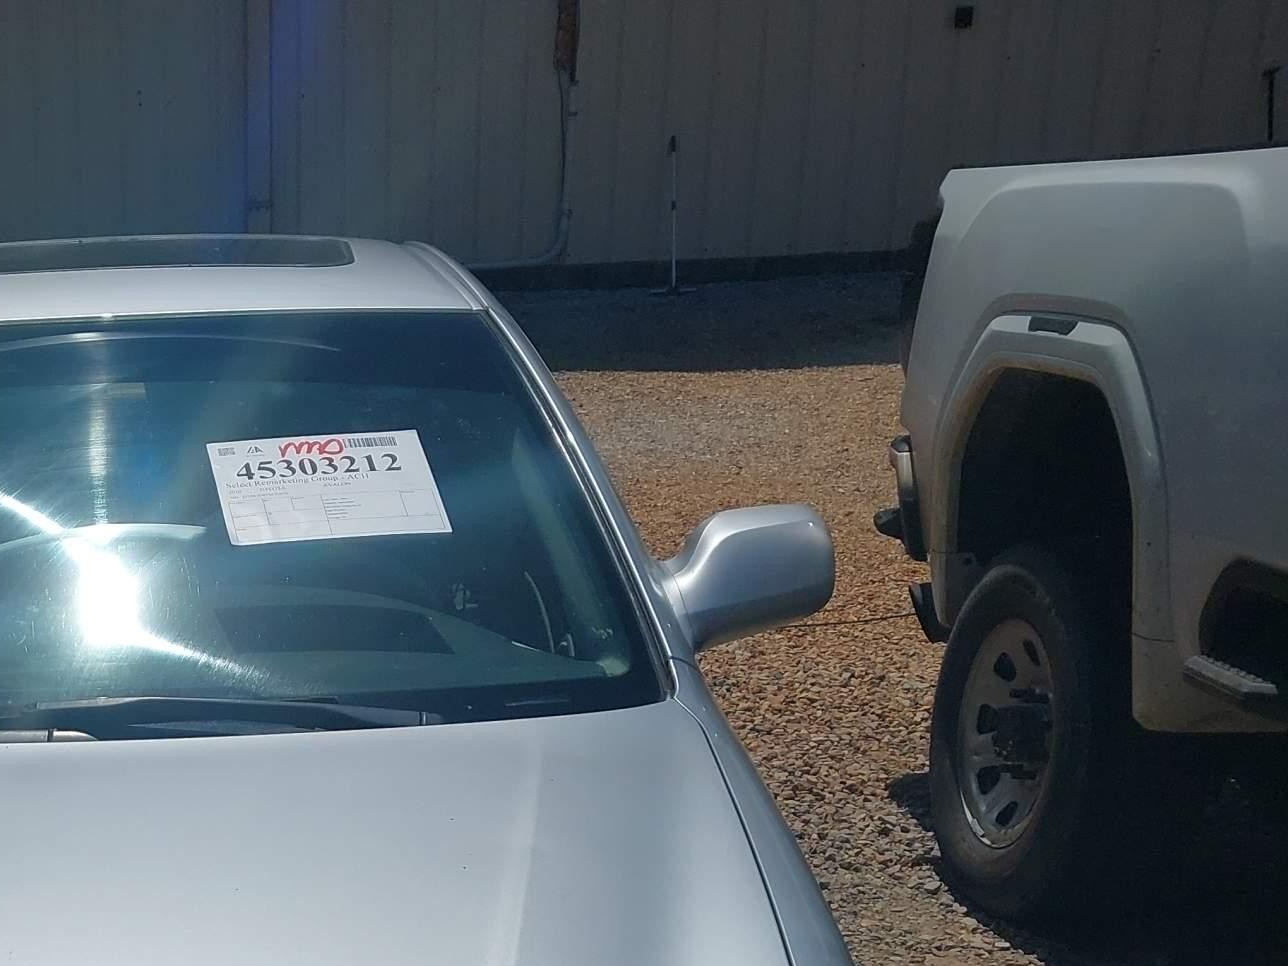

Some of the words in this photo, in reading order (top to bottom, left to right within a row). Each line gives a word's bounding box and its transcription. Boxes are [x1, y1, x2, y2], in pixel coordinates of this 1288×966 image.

[236, 452, 402, 481] 45303212
[225, 481, 252, 489] Select
[253, 476, 310, 487] Remarketing
